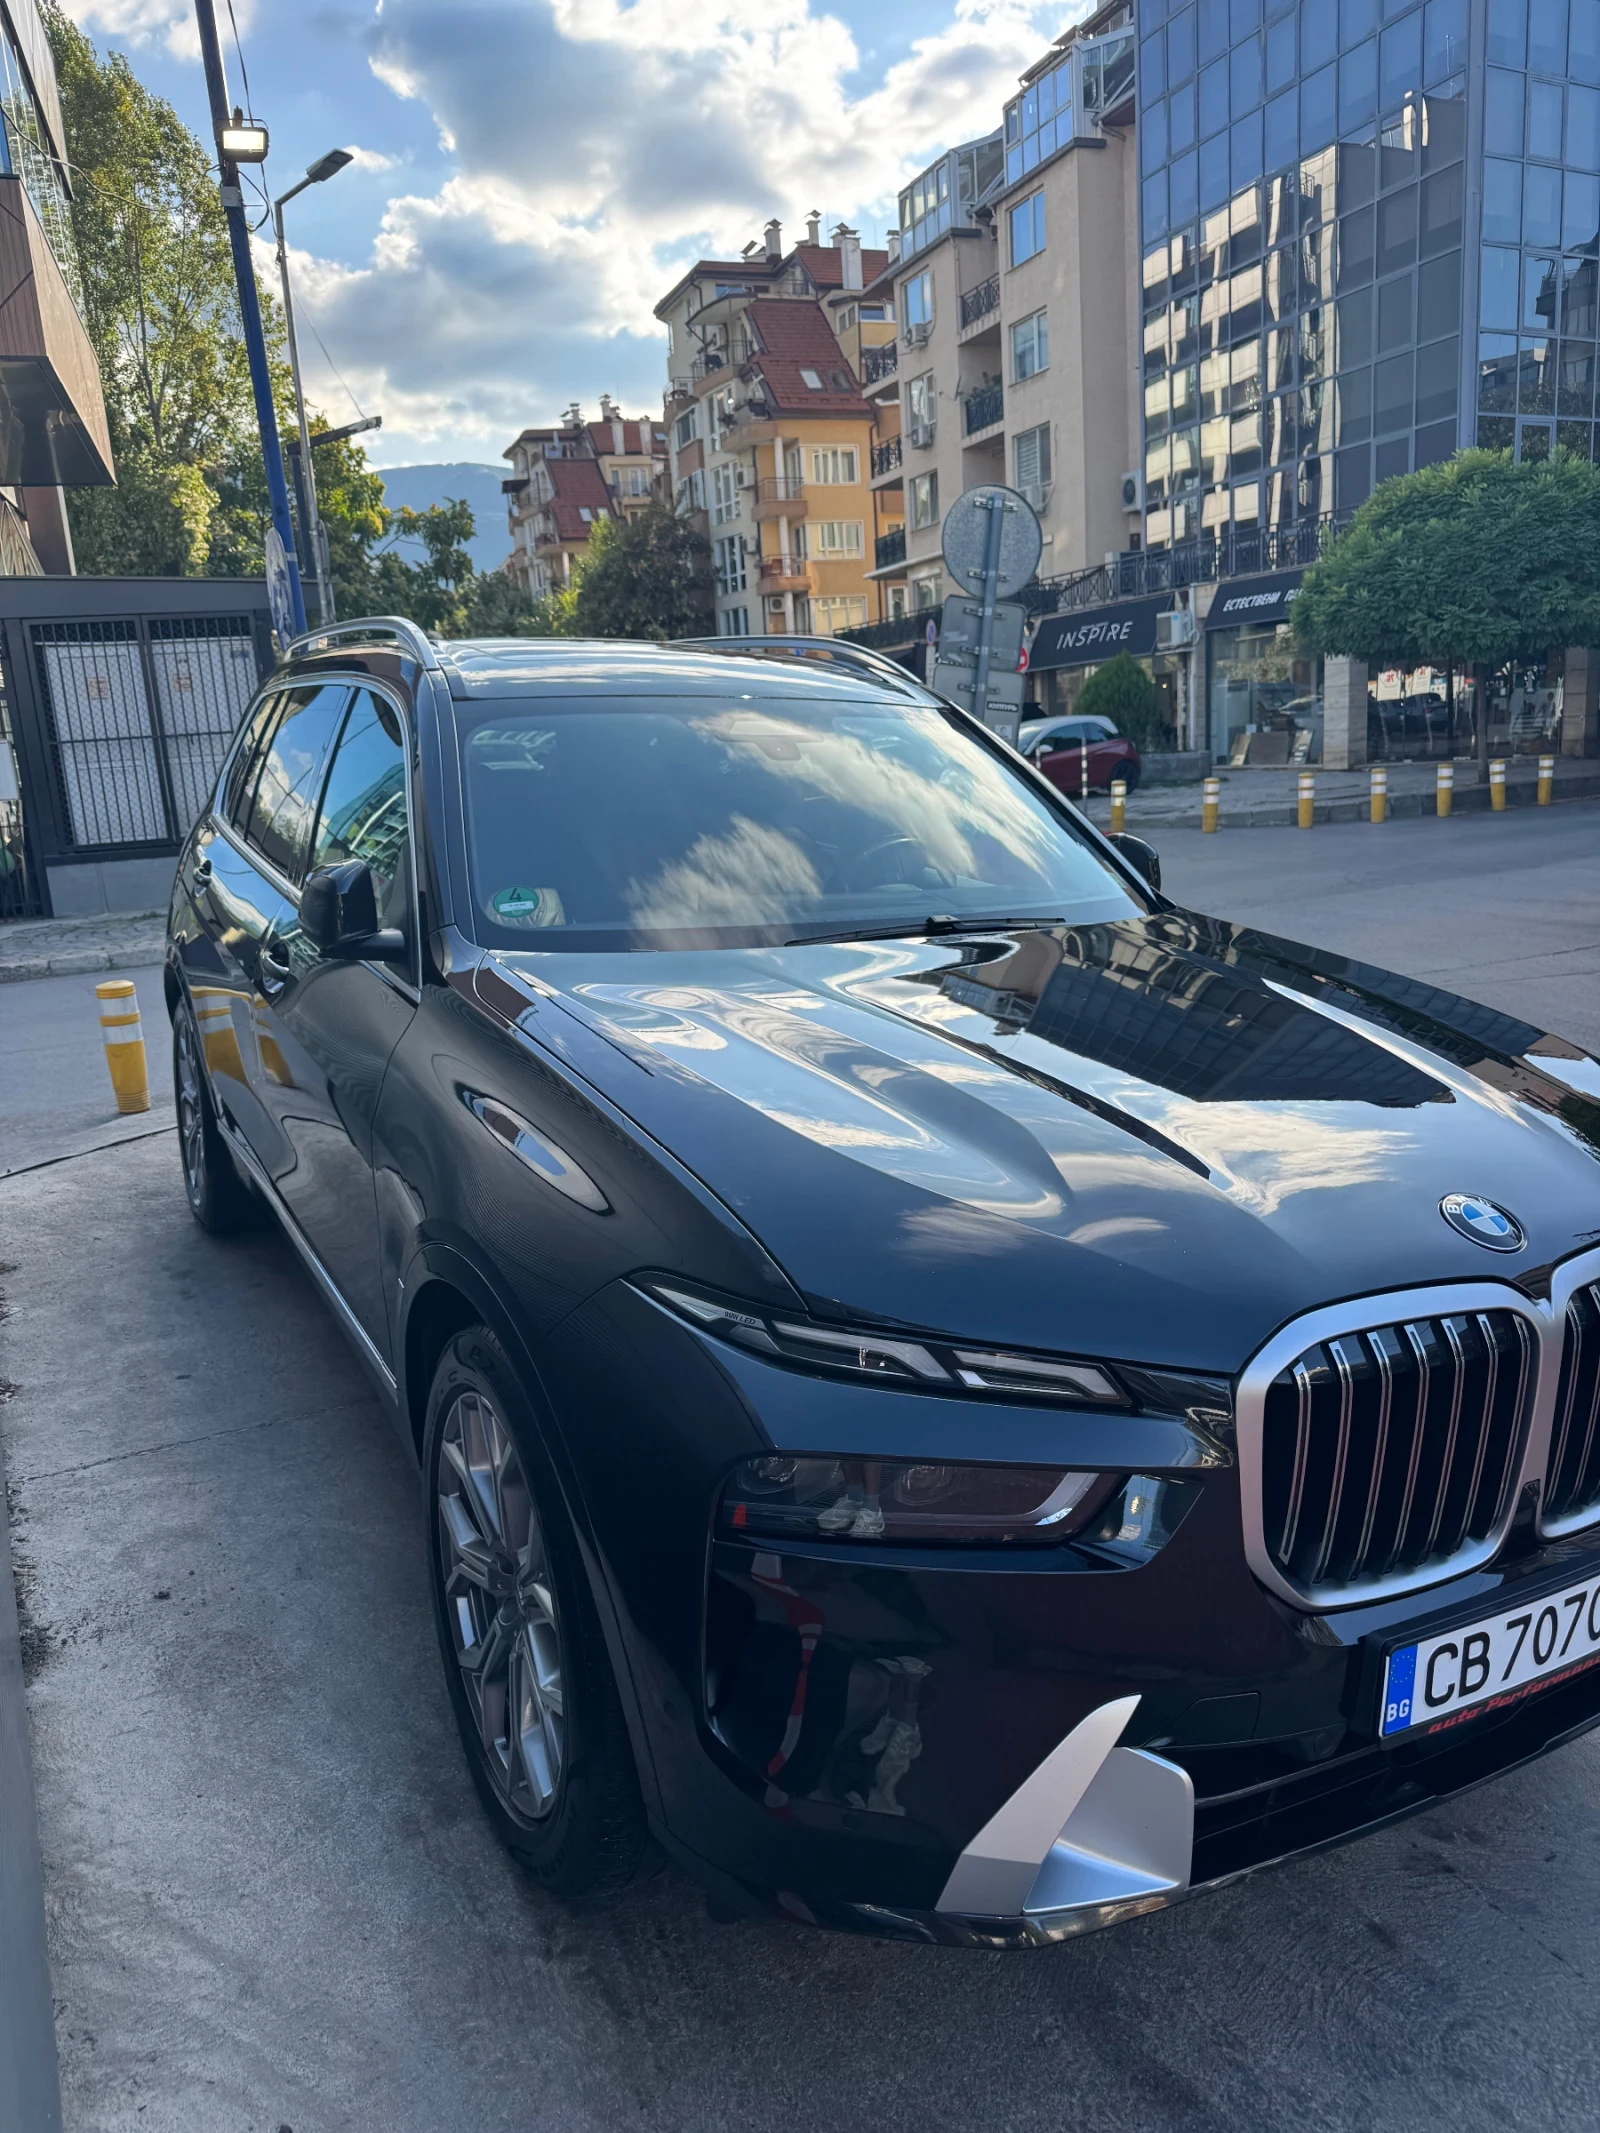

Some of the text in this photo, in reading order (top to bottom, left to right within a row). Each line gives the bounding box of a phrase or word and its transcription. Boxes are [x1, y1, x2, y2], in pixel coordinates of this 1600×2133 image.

[1222, 590, 1282, 612] ЕСТЕСТВЕНИ
[1055, 620, 1134, 651] INSPIRE
[509, 887, 522, 902] 4
[739, 1315, 756, 1325] LED
[1425, 1632, 1490, 1708] CB
[1386, 1698, 1411, 1723] BG
[1428, 1706, 1483, 1734] auto
